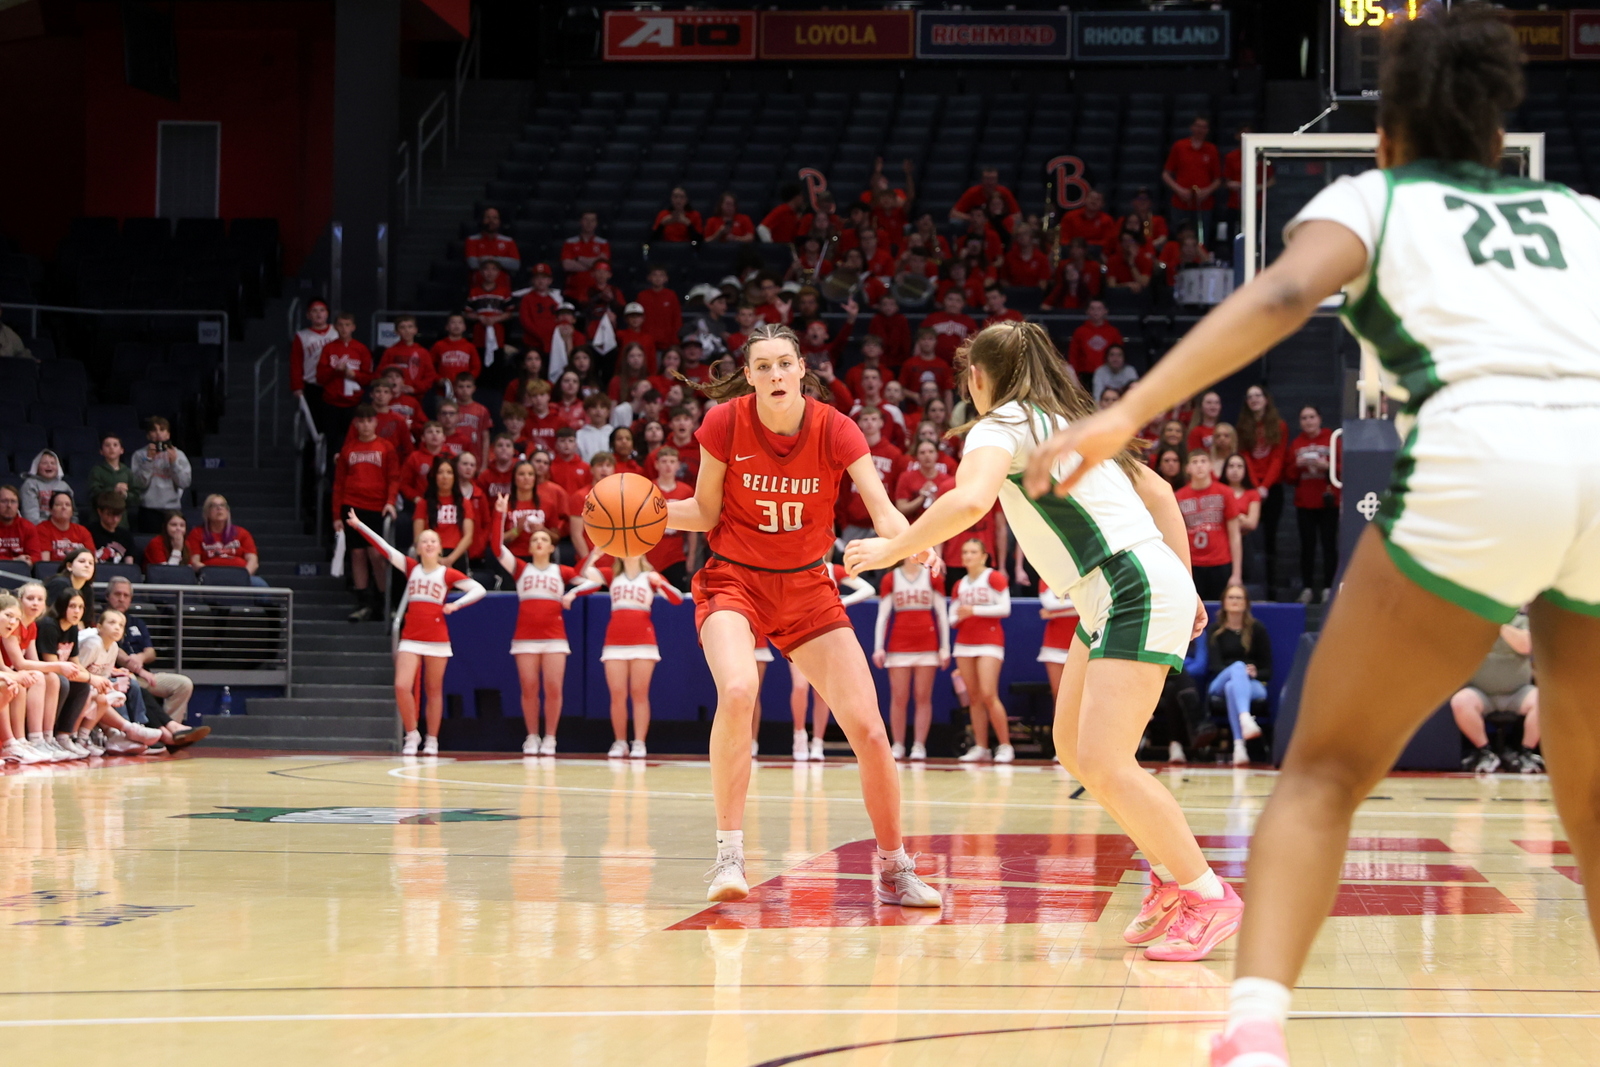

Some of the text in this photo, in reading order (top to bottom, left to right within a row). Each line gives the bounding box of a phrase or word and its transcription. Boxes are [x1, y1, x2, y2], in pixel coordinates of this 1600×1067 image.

[795, 24, 877, 45] LOYOLA
[931, 24, 1056, 46] RICHMOND
[1083, 26, 1219, 45] RHODE ISLAND
[1046, 155, 1092, 209] B
[1443, 194, 1568, 270] 25
[742, 473, 820, 495] BELLEVUE
[755, 499, 804, 532] 30
[408, 579, 443, 600] BHS
[523, 574, 560, 594] BHS
[612, 584, 647, 604] BHS
[895, 590, 932, 607] BHS
